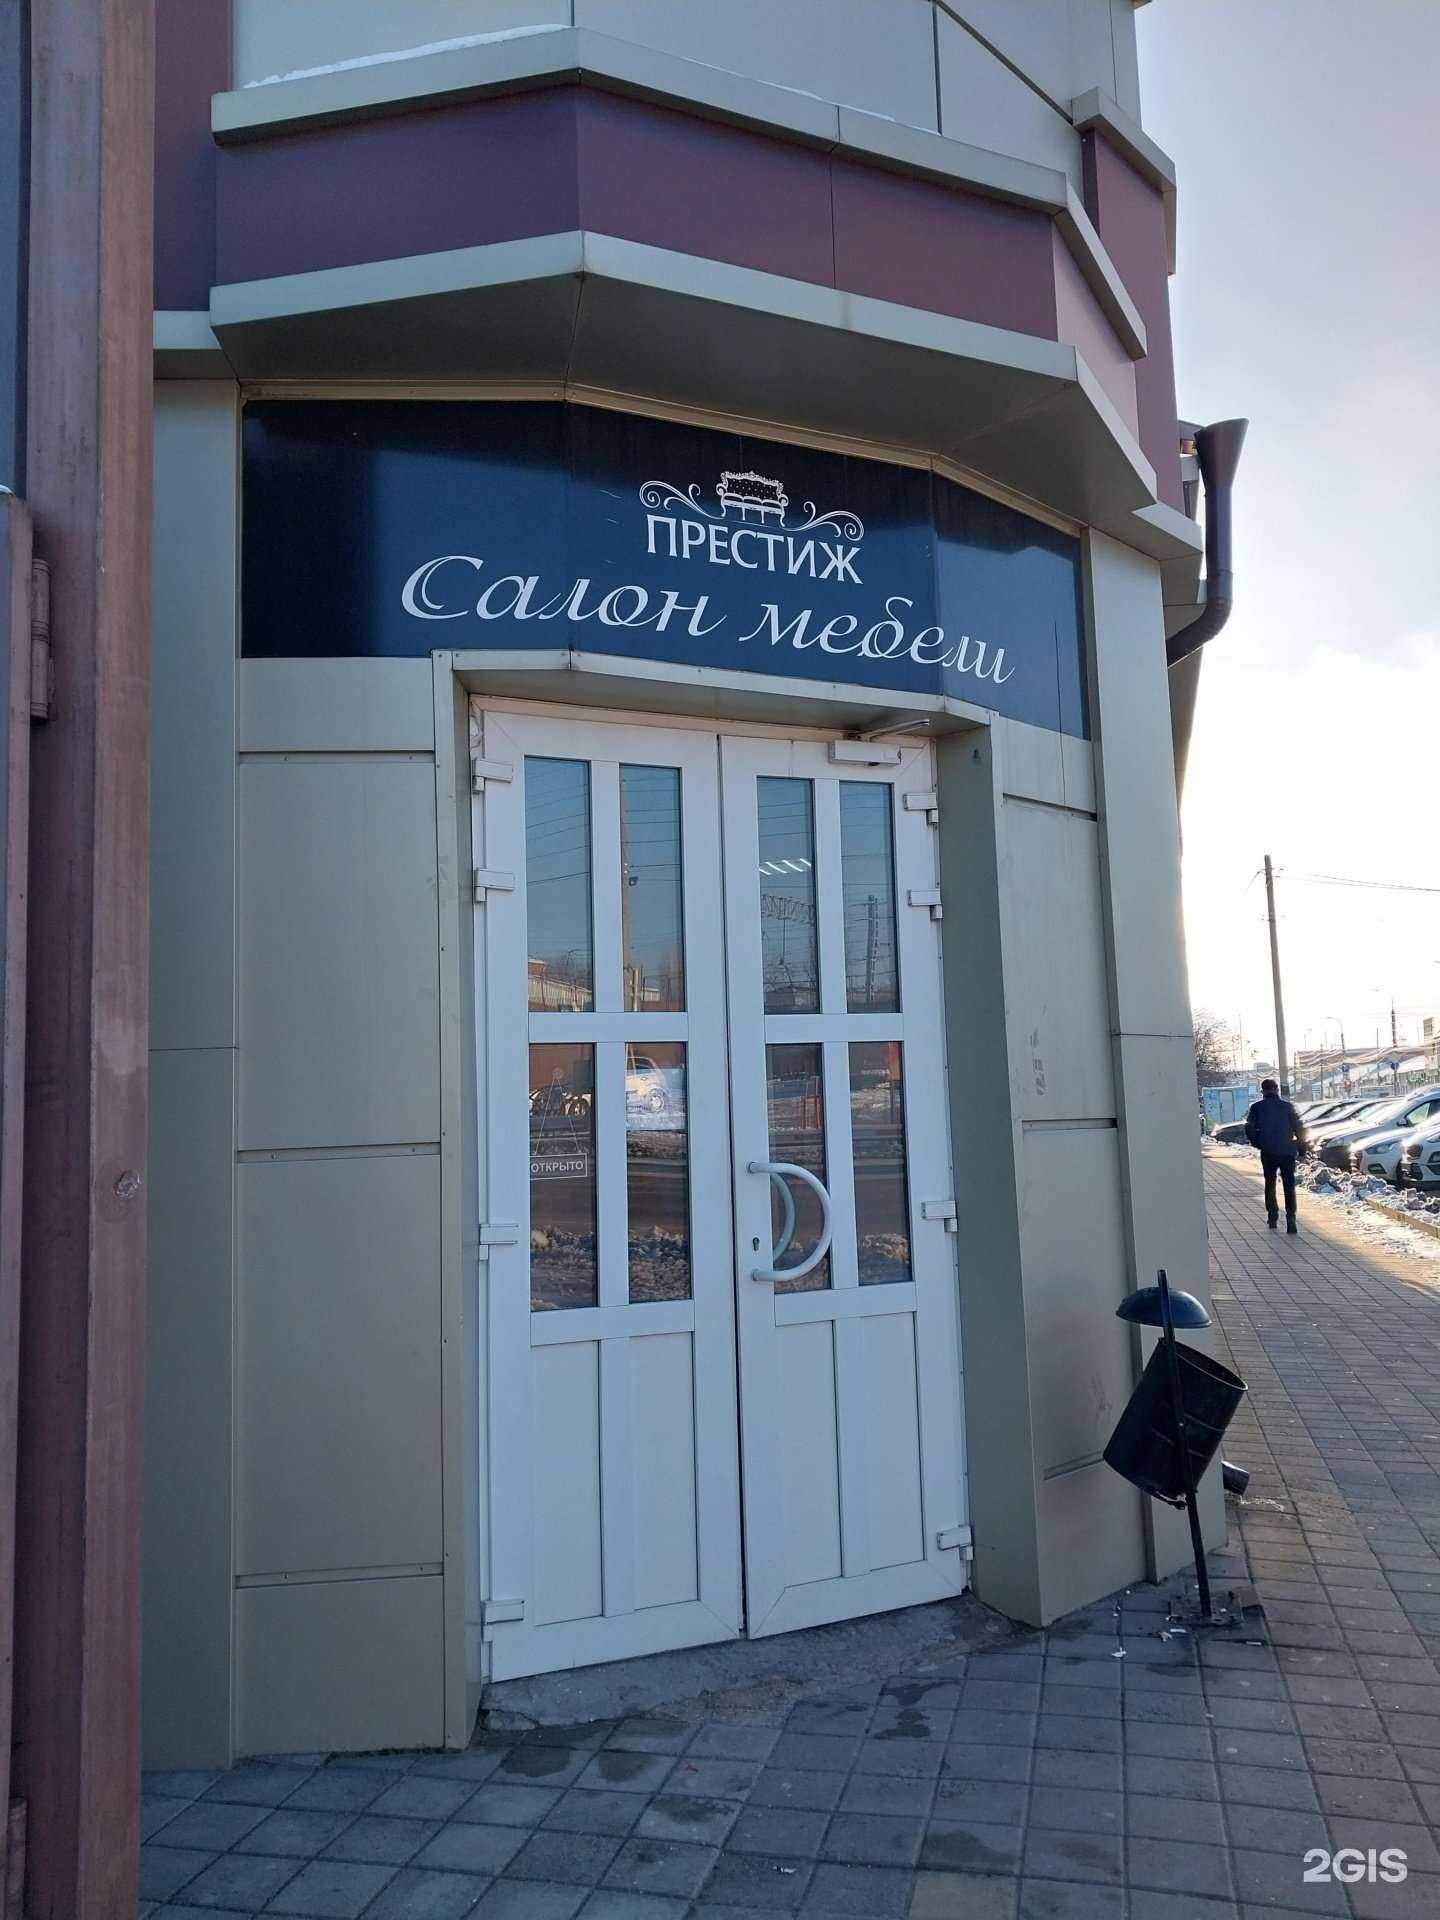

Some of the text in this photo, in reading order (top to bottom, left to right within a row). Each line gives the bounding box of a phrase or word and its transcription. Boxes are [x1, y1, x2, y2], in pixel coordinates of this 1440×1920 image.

[646, 514, 864, 585] ПРЕСТИЖ
[401, 555, 1016, 684] Салон мебели
[530, 1160, 584, 1173] ОТКРЫТО
